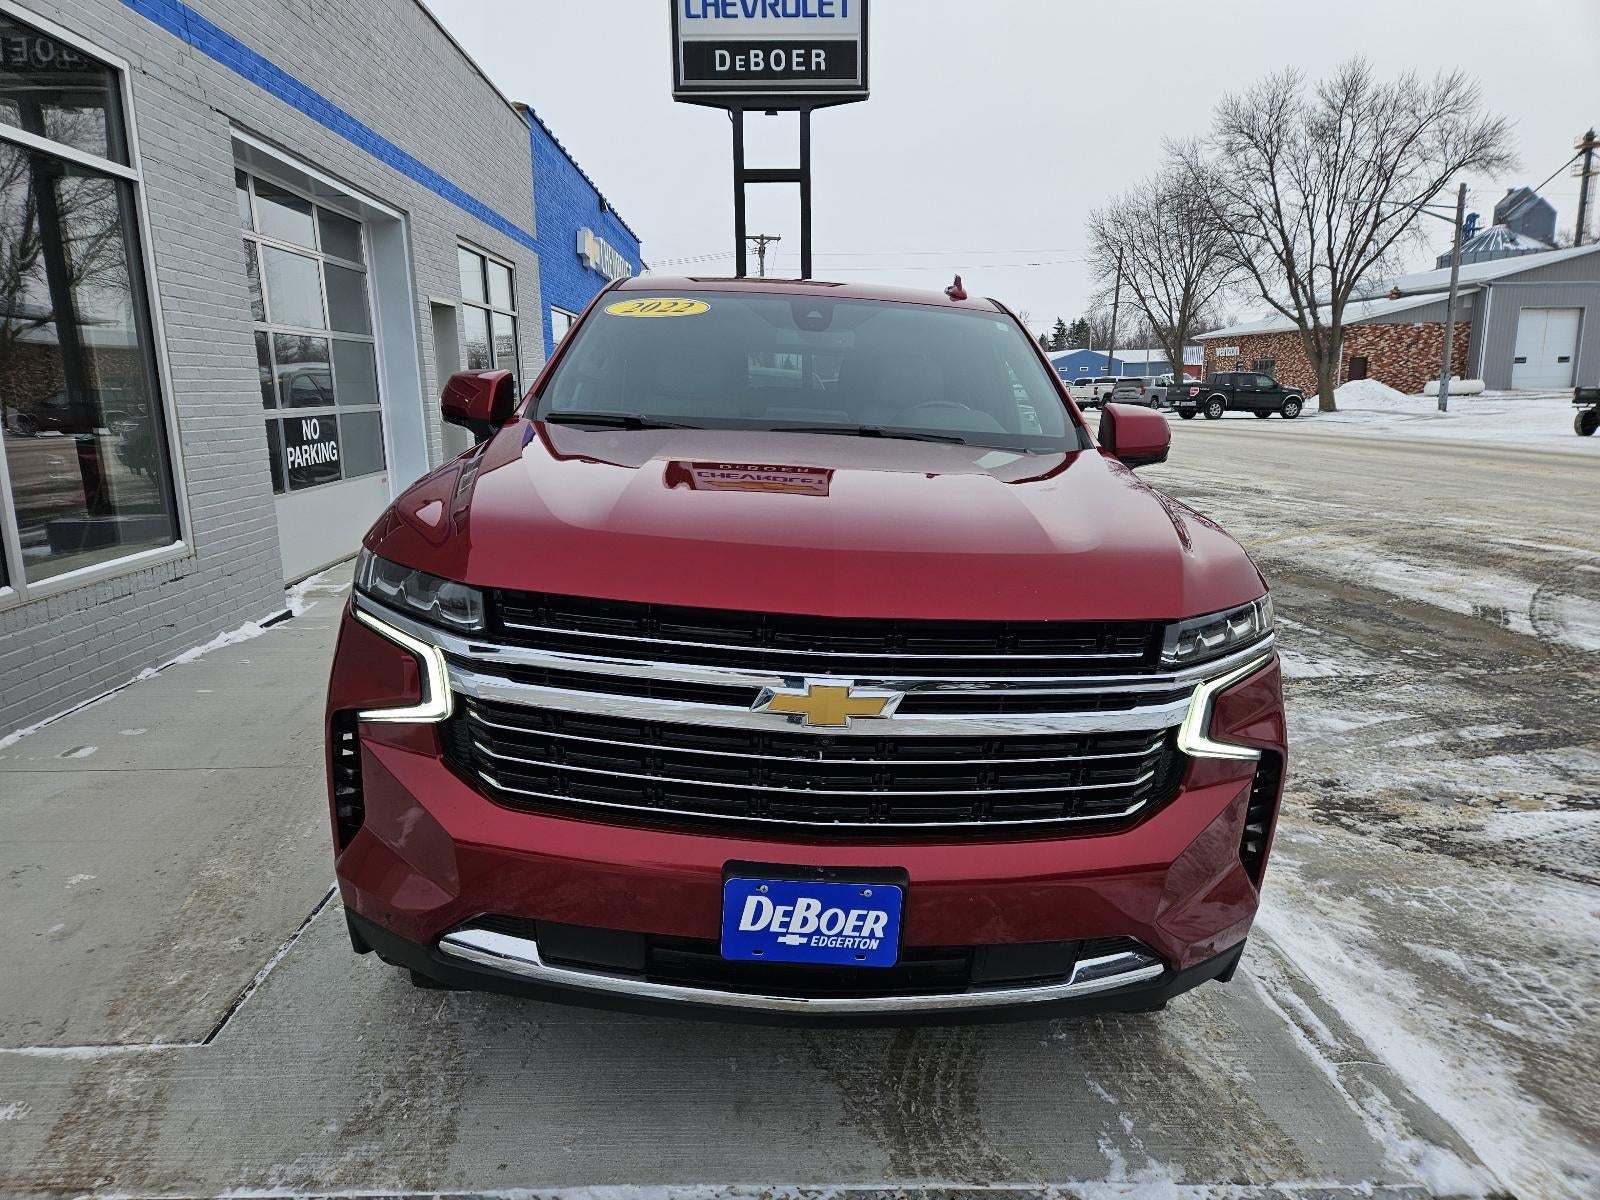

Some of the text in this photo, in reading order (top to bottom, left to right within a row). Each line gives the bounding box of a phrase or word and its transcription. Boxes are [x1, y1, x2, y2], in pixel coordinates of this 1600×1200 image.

[621, 301, 695, 313] 2022
[1215, 343, 1240, 357] verizon
[302, 418, 320, 441] NO
[286, 440, 338, 469] PARKING
[810, 935, 880, 950] EDGERTON
